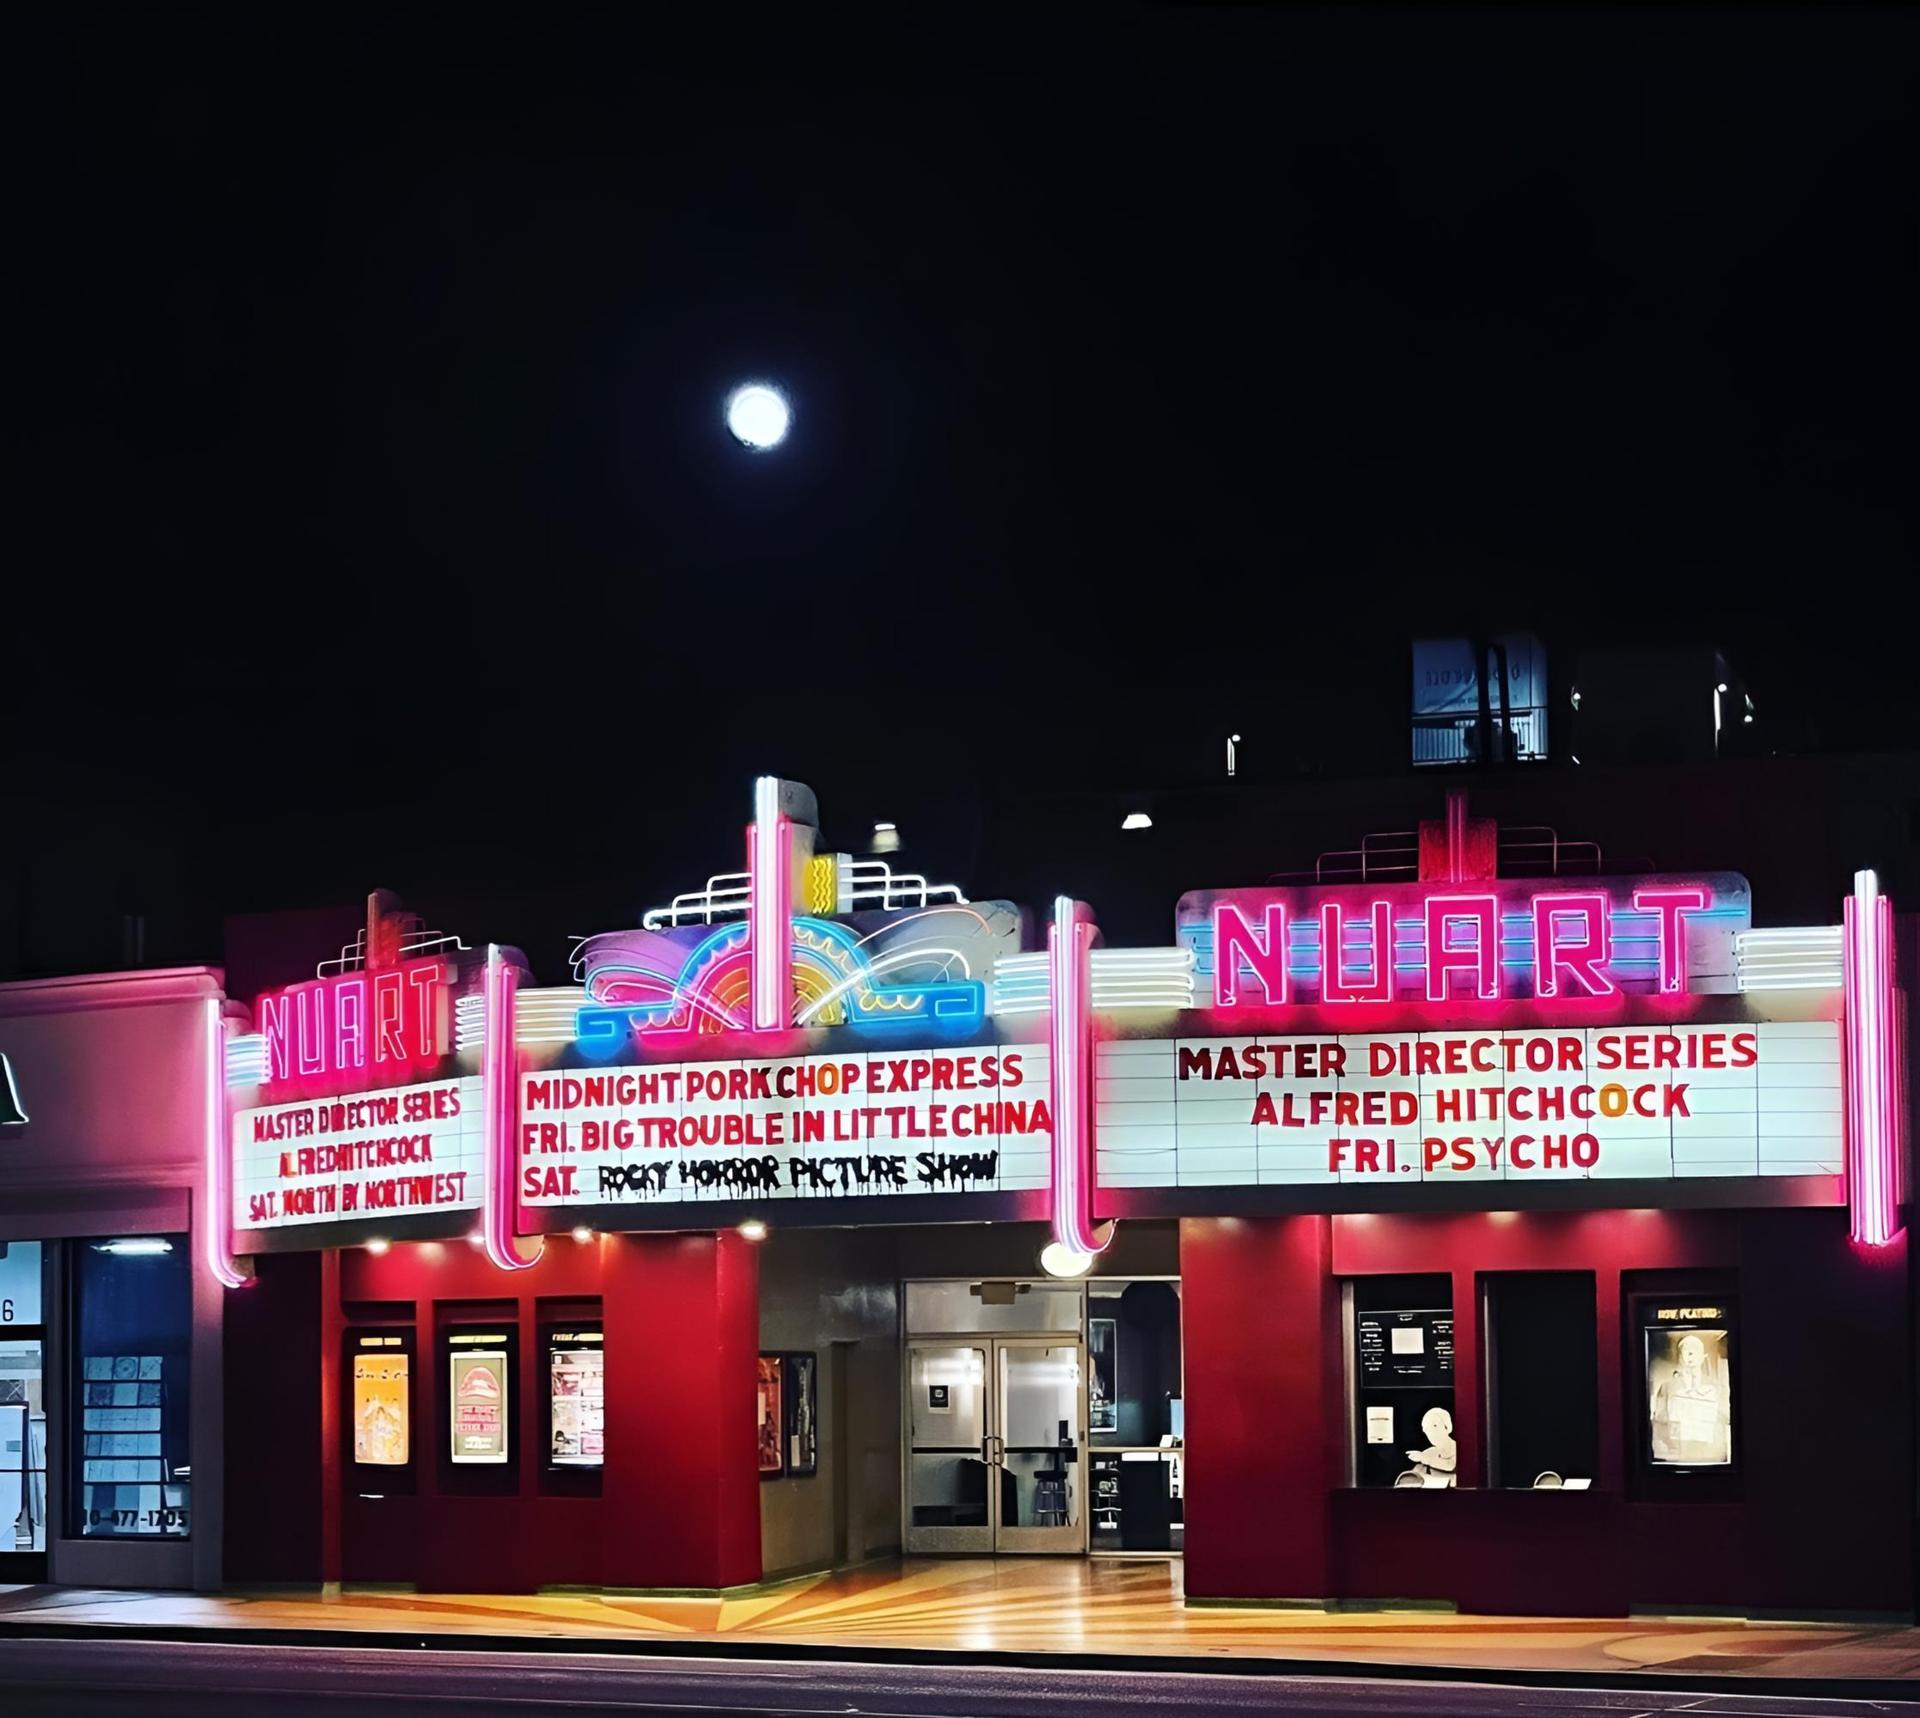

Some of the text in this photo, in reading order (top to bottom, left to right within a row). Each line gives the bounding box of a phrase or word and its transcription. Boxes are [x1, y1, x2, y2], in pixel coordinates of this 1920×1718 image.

[1213, 892, 1704, 1007] NUART
[261, 964, 439, 1080] NUART
[526, 1054, 1024, 1111] MIDNIGHT PORK CHOP EXPRESS
[1178, 1032, 1758, 1080] MASTER DIRECTOR SERIES
[253, 1086, 461, 1143] MASTER DIRECTOR SERIES
[522, 1098, 1052, 1155] FRI. BIG TROUBLE IN LITTLE CHINA
[1250, 1082, 1691, 1128] ALFRED HITCHCOCK
[523, 1150, 999, 1199] SAT. ROCKY HORROR PICTURE SHOW
[1328, 1132, 1600, 1173] FRI. PSYCHO
[282, 1183, 336, 1217] NORTH
[341, 1182, 360, 1212] BY
[364, 1170, 468, 1210] NORTHWEST
